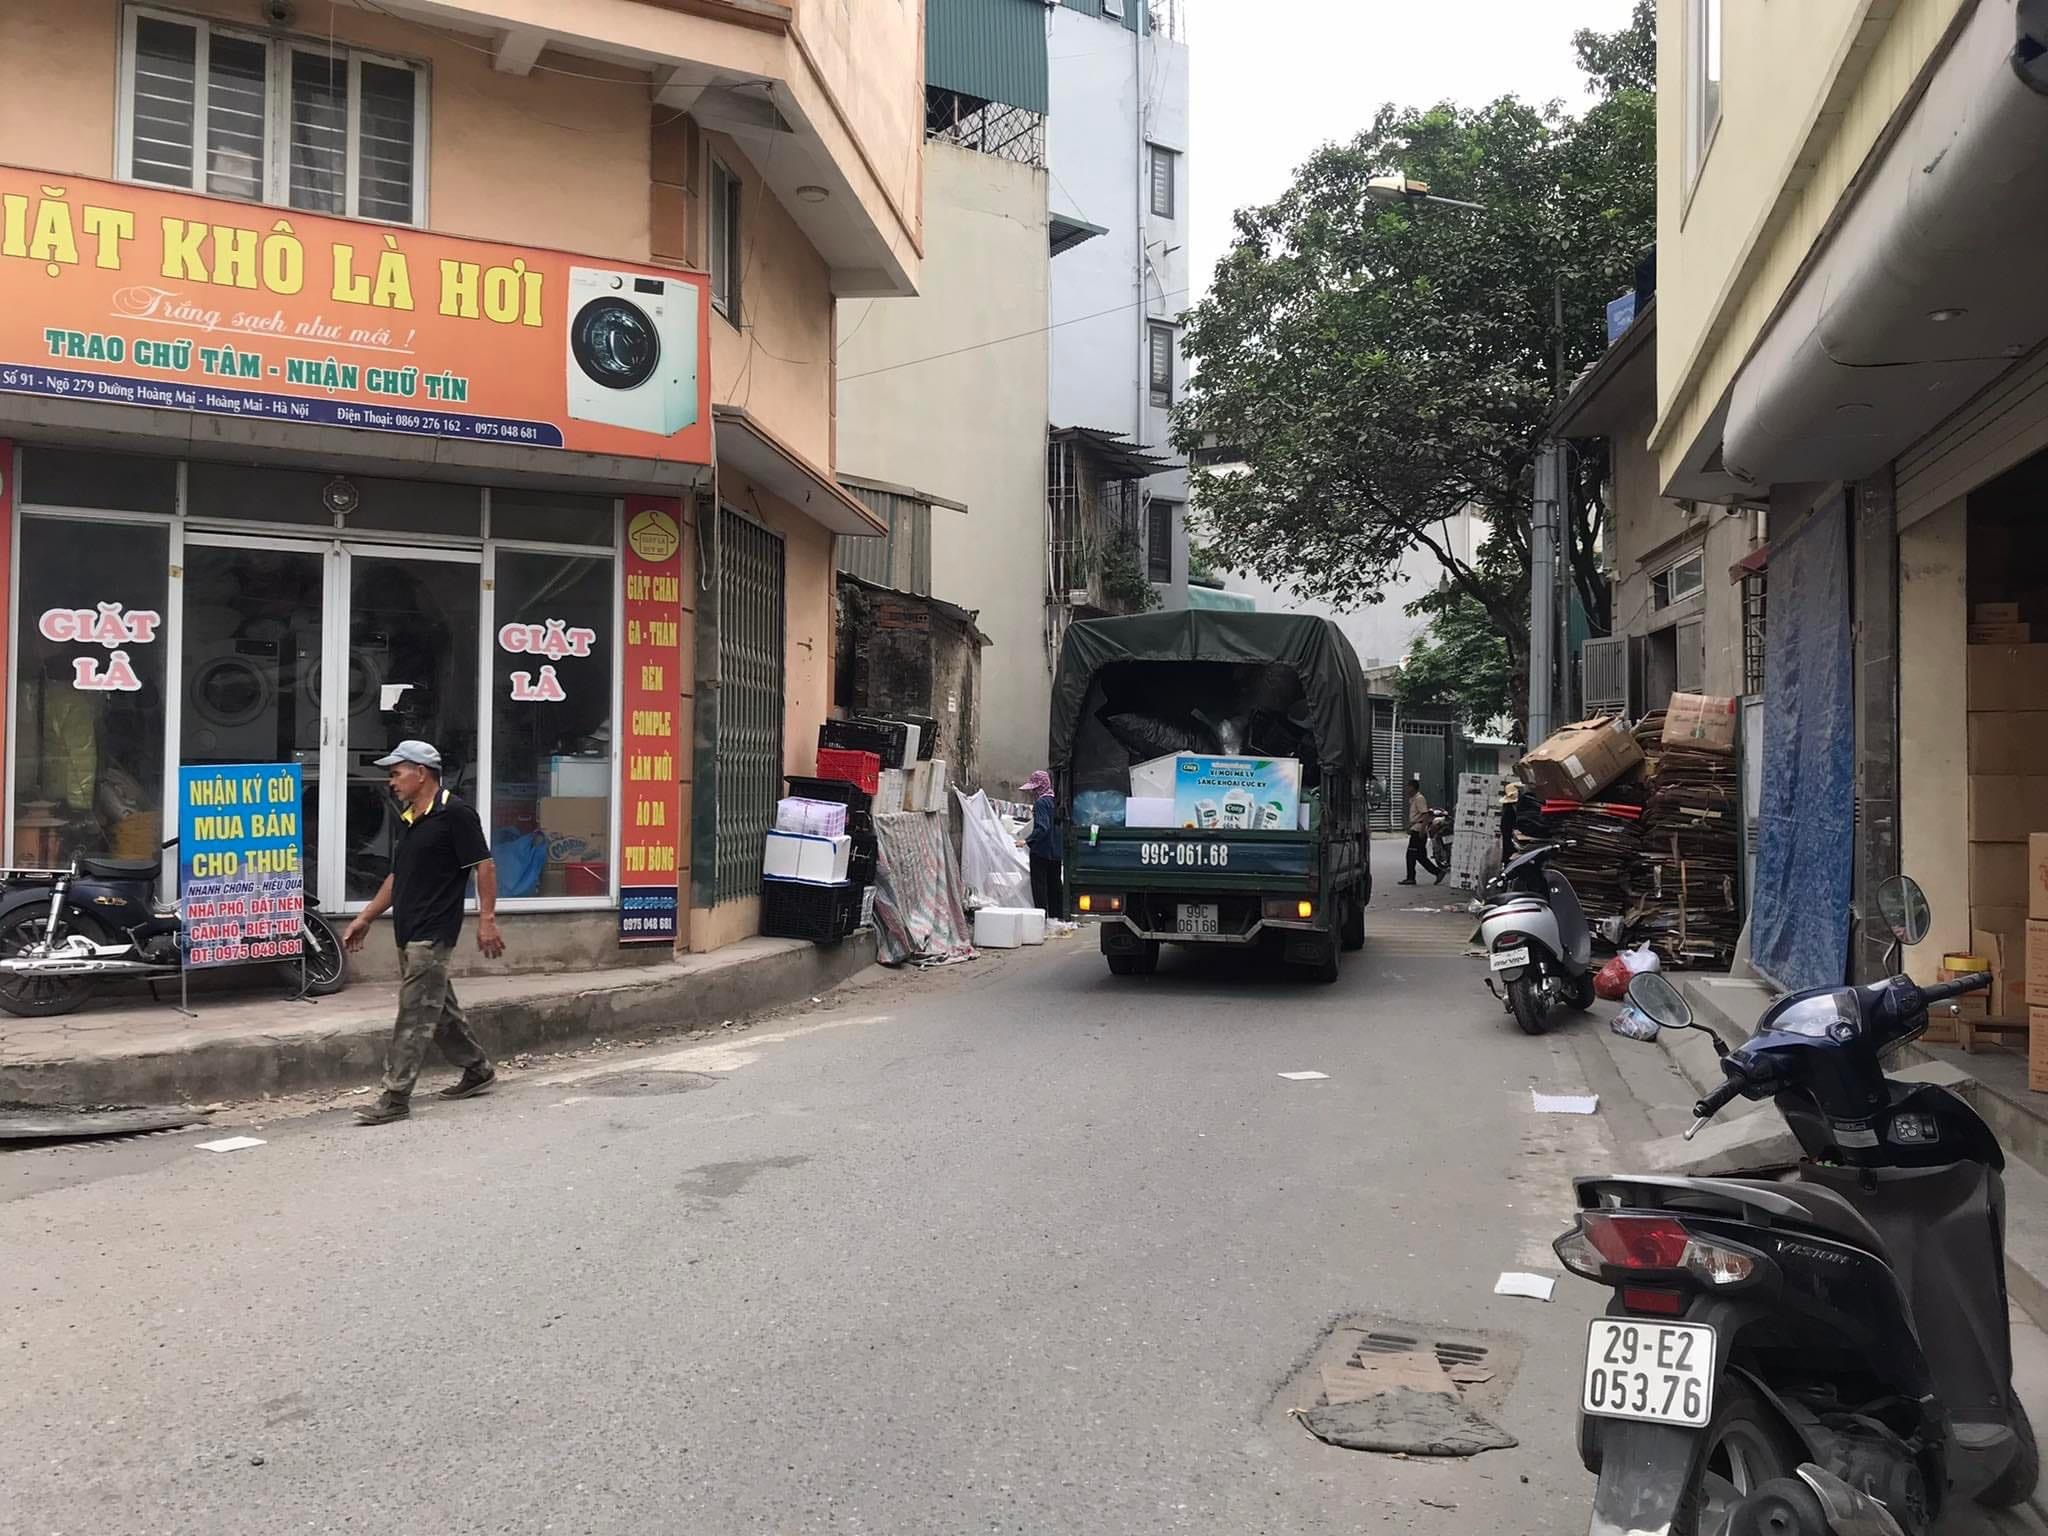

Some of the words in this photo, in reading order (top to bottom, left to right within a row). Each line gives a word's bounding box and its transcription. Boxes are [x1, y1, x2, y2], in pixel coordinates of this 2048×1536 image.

[160, 216, 304, 295] KHÔ
[331, 234, 415, 311] LÀ
[439, 257, 545, 328] HƠI
[112, 285, 222, 332] Trắng
[231, 309, 286, 332] sạch
[295, 314, 342, 339] như
[350, 326, 392, 346] mới
[44, 328, 125, 363] TRAO
[133, 338, 192, 371] CHỮ
[200, 344, 262, 380] TÂM
[286, 356, 360, 393] NHẬN
[366, 366, 418, 397] CHỮ
[424, 370, 468, 403] TÍN
[3, 369, 18, 385] Số
[20, 373, 34, 386] 91
[46, 376, 70, 394] Ngõ
[73, 379, 95, 393] 279
[98, 382, 134, 401] Đường
[137, 387, 173, 405] Hoàng
[175, 390, 196, 405] Mai
[206, 394, 241, 412] Hoàng
[243, 398, 263, 412] Mai
[273, 401, 288, 415] Hà
[290, 403, 309, 418] Nội
[337, 407, 361, 424] Điện
[364, 411, 393, 427] Thoại:
[395, 414, 420, 428] 0869
[422, 417, 440, 430] 276
[443, 419, 461, 432] 162
[475, 422, 498, 435] 0975
[500, 424, 518, 437] 048
[521, 426, 538, 440] 681
[39, 601, 161, 648] GIẶT
[499, 618, 597, 660] GIẶT
[628, 620, 641, 645] GA
[72, 650, 142, 691] LÀ
[510, 665, 567, 702] LÀ
[632, 710, 672, 736] COMPLE
[630, 748, 651, 781] LÀM
[190, 774, 238, 811] NHẬN
[242, 773, 262, 804] KÝ
[268, 769, 295, 803] GỬI
[194, 815, 245, 841] MUA
[251, 808, 296, 838] BÁN
[636, 794, 650, 826] ÁO
[192, 851, 238, 878] CHO
[244, 843, 299, 874] THUÊ
[625, 840, 646, 871] THÚ
[1141, 843, 1228, 866] 99C-061.68
[188, 885, 221, 897] NHANH
[188, 900, 215, 919] NHÀ
[1178, 919, 1217, 933] 061.68
[1186, 905, 1209, 918] 99C
[191, 922, 219, 940] CĂN
[245, 918, 273, 938] BIỆT
[191, 948, 213, 964] ĐT:
[215, 944, 249, 960] 0975
[251, 941, 276, 958] 048
[279, 939, 303, 955] 681
[1603, 1325, 1694, 1372] 29-E2
[1590, 1368, 1702, 1418] 053.76
